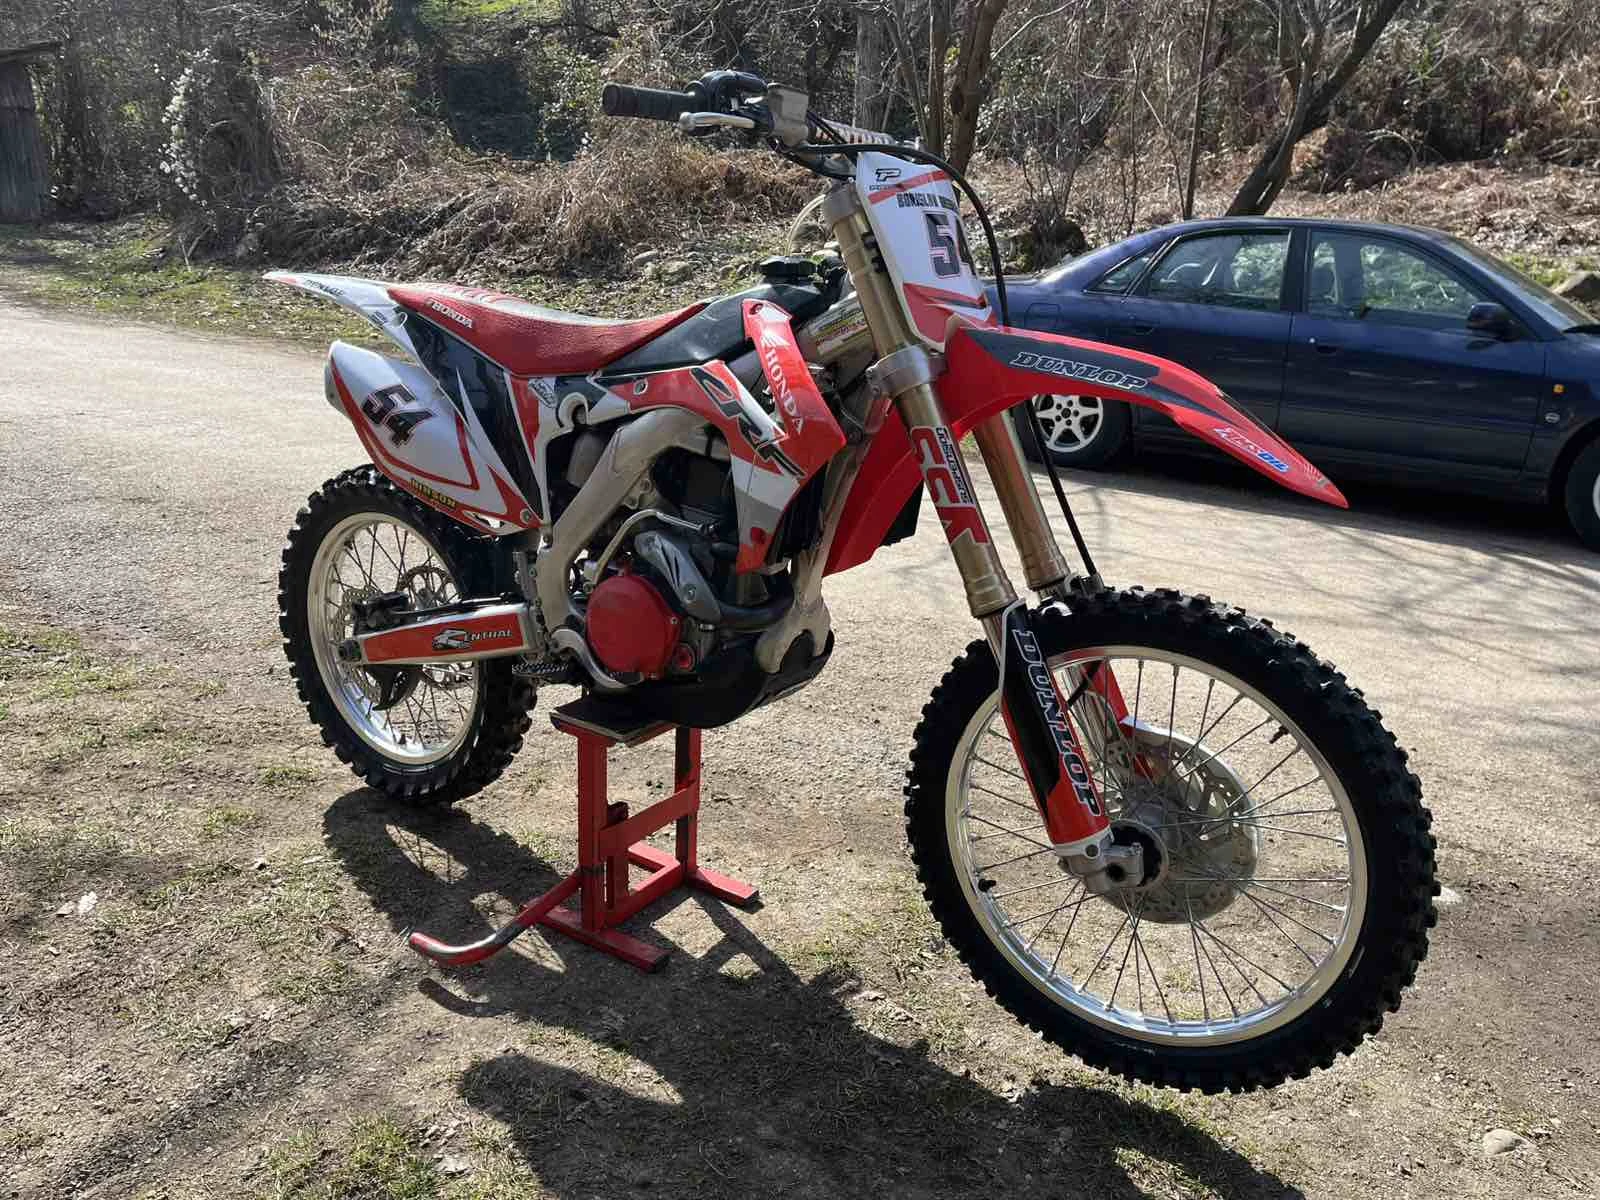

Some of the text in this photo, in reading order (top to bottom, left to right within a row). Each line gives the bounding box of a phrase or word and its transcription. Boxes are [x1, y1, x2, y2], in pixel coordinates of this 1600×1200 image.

[431, 301, 472, 329] HONDA
[764, 351, 803, 433] HONDA
[1010, 351, 1148, 390] DUNLOP
[361, 383, 435, 448] 54
[690, 365, 807, 477] CRF
[1012, 629, 1101, 816] DUNLOP
